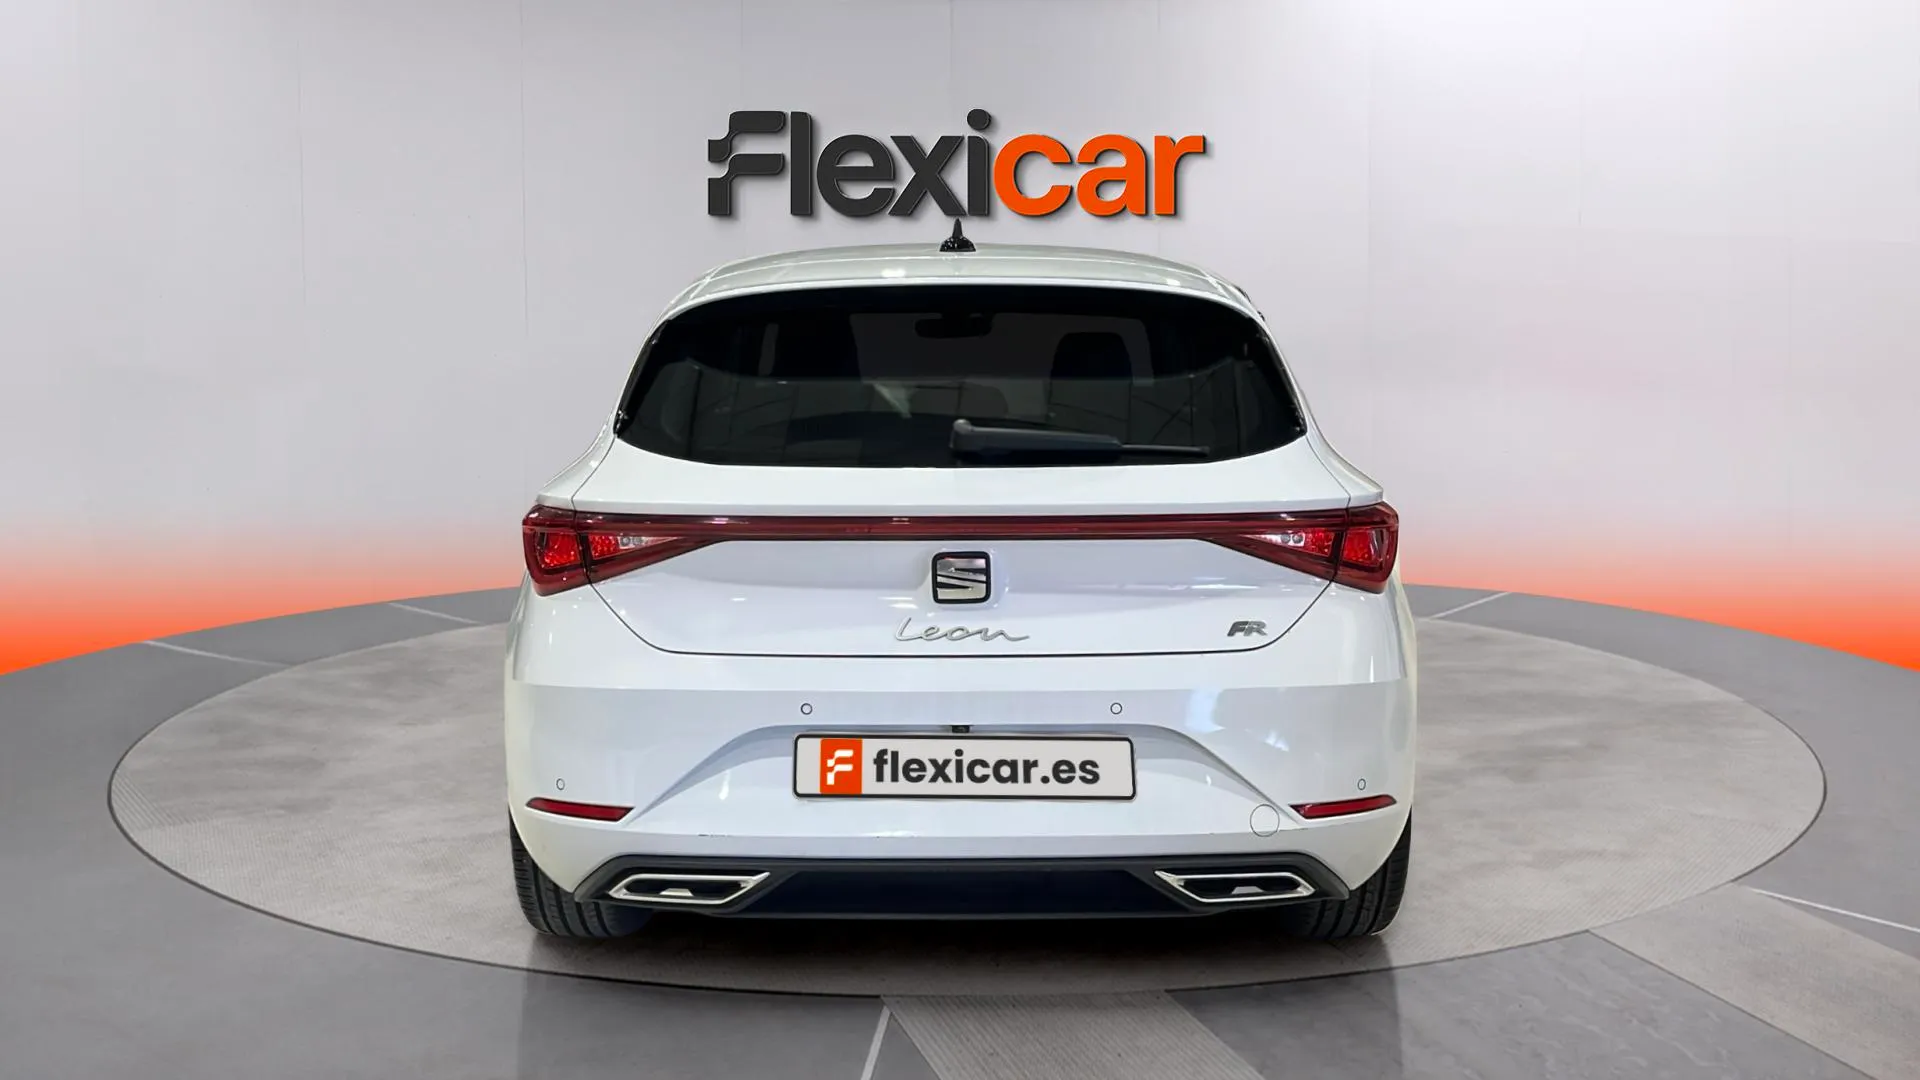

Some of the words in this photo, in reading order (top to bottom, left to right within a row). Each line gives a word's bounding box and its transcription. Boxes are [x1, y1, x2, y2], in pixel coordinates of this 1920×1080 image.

[707, 108, 1206, 217] Flexicar
[895, 617, 1030, 642] Leon
[1226, 620, 1268, 638] FR
[873, 748, 1101, 785] flexicar.es
